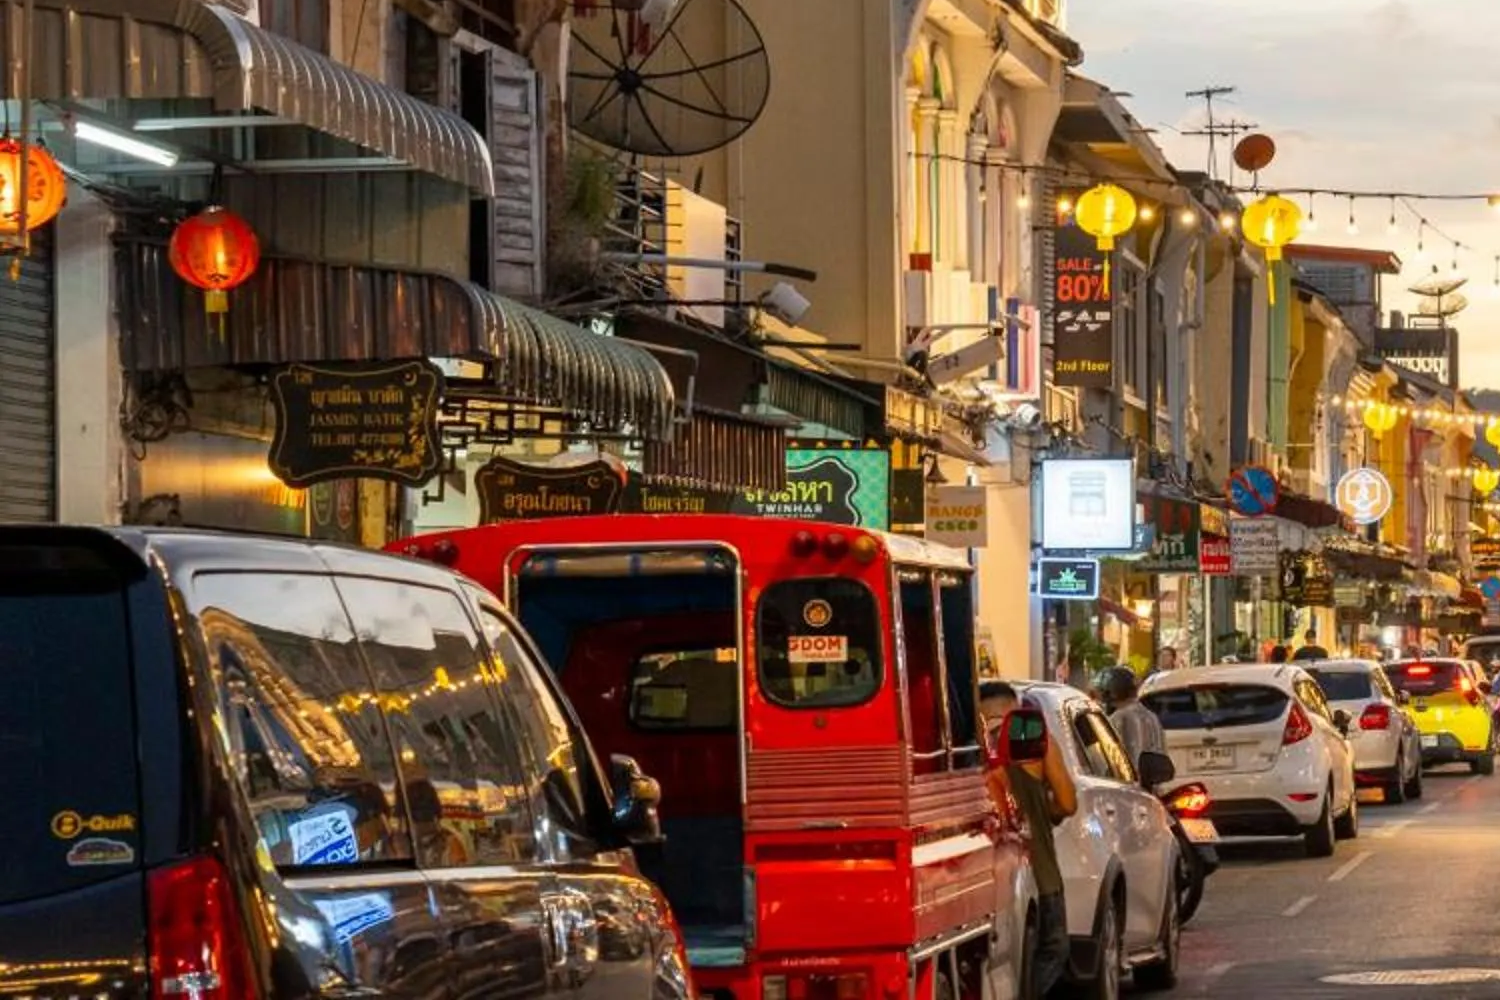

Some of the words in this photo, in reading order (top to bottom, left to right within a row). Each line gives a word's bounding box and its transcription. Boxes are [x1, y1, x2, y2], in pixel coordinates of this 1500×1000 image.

[1057, 258, 1092, 271] SALE
[1056, 360, 1077, 371] 2nd
[1080, 360, 1111, 371] Floor
